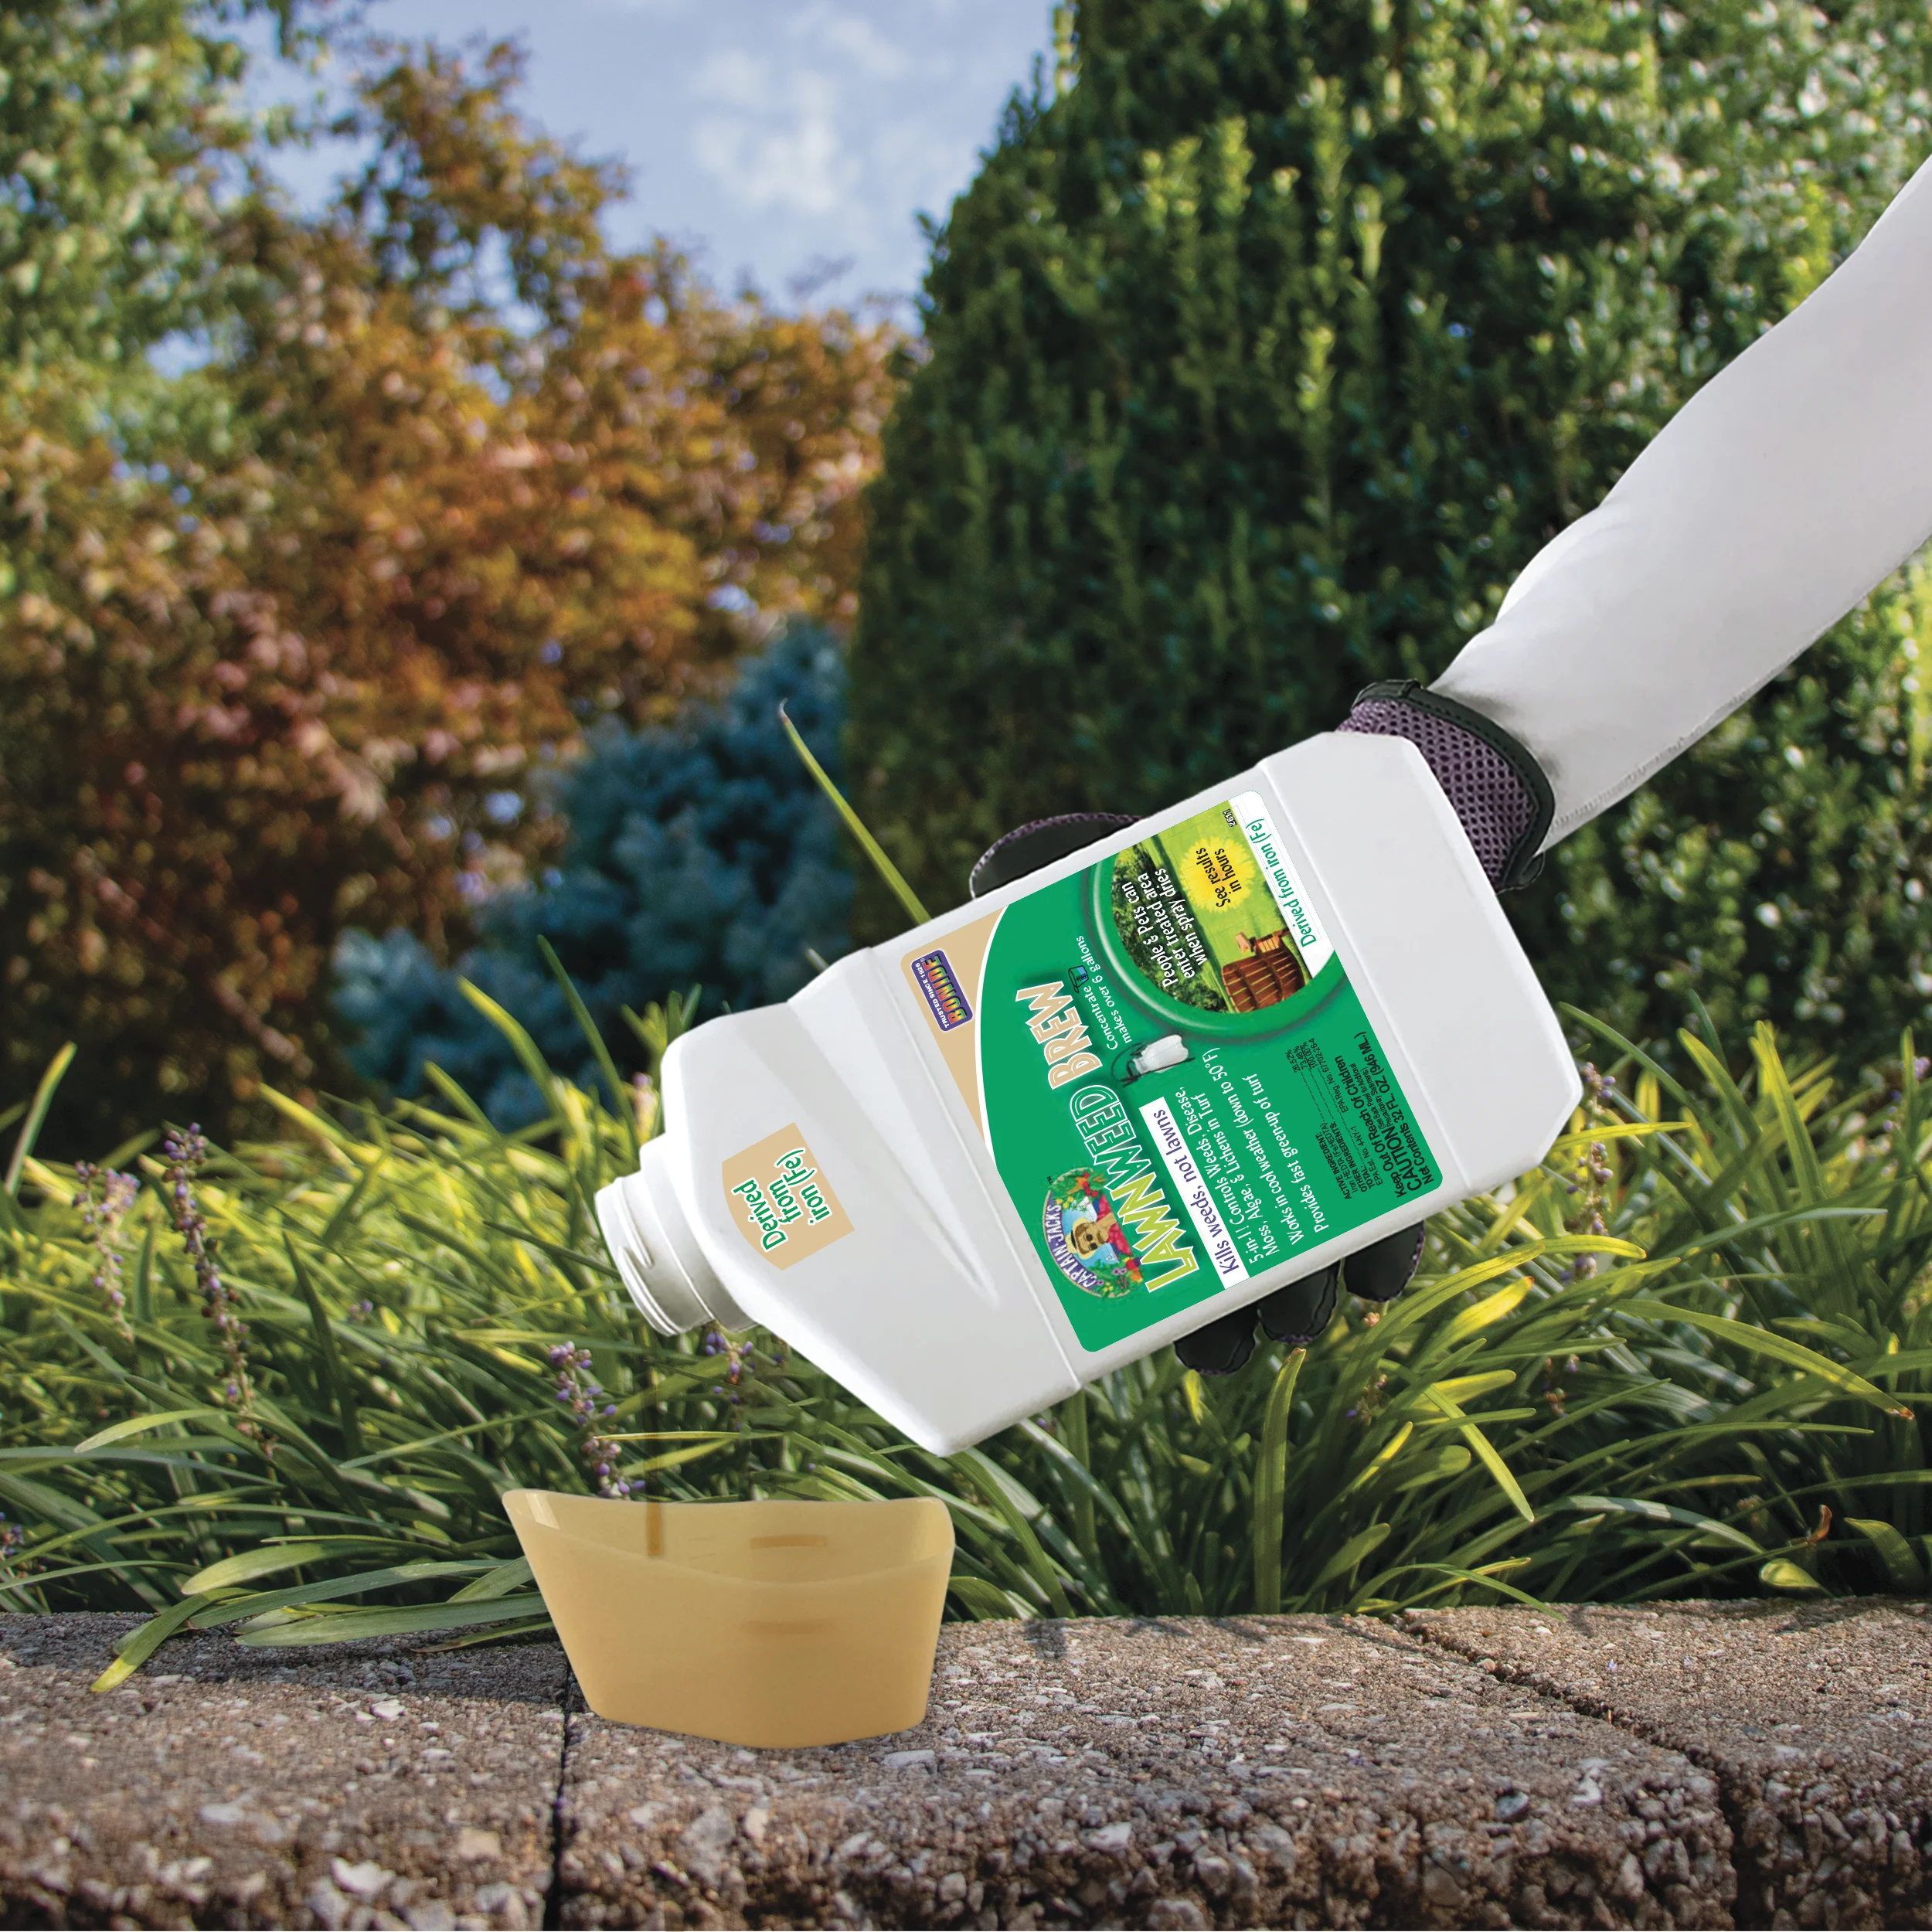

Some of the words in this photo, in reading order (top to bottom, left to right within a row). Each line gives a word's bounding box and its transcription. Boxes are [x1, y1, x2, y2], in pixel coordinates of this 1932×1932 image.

[1222, 808, 1237, 828] 2611
[1244, 818, 1272, 844] (Fe)
[1196, 847, 1220, 884] results
[1214, 848, 1235, 881] hours
[1260, 842, 1280, 869] iron
[1121, 881, 1140, 903] can
[1137, 872, 1158, 900] area
[1154, 868, 1176, 897] dries
[1214, 886, 1230, 907] See
[1228, 879, 1242, 893] in
[1273, 868, 1294, 899] from
[1132, 905, 1154, 935] Pets
[1145, 900, 1179, 947] treated
[1168, 898, 1195, 930] spray
[1282, 898, 1317, 947] Derived
[1076, 935, 1100, 972] gallons
[1142, 934, 1158, 945] &
[1184, 931, 1207, 965] when
[914, 961, 926, 978] 1926
[1149, 944, 1179, 988] People
[1171, 947, 1195, 978] enter
[921, 978, 935, 998] SINCE
[922, 955, 967, 1025] BONIDE
[1091, 975, 1103, 983] 6
[1098, 985, 1114, 1007] over
[932, 998, 950, 1029] TRUSTED
[1083, 985, 1118, 1049] Concentrate
[1110, 1009, 1132, 1043] makes
[1014, 980, 1103, 1090] BREW
[1353, 1031, 1372, 1055] ML.)
[1284, 1049, 1301, 1073] 26.52%
[1292, 1045, 1308, 1070] 73.48%
[1300, 1041, 1318, 1070] 100.00%
[1308, 1037, 1329, 1073] 67702-26-4
[1363, 1053, 1385, 1076] (946
[1220, 1080, 1234, 1094] to
[1241, 1073, 1264, 1096] turf
[1326, 1073, 1335, 1084] No.
[1334, 1054, 1359, 1096] Children
[1175, 1087, 1202, 1135] Disease,
[1189, 1092, 1213, 1119] Turf
[1227, 1093, 1253, 1128] (down
[1252, 1096, 1270, 1109] of
[1337, 1097, 1349, 1113] EPA
[1349, 1095, 1365, 1109] Of
[1384, 1092, 1399, 1111] FL.
[1390, 1108, 1404, 1123] 32
[1153, 1109, 1182, 1155] lawns
[1206, 1117, 1220, 1132] in
[1264, 1111, 1298, 1158] green-up
[1349, 1124, 1364, 1146] 4-NY-1
[1358, 1107, 1380, 1141] Reach
[1196, 1134, 1221, 1179] Weeds,
[1213, 1131, 1240, 1174] Lichens
[1243, 1128, 1270, 1172] weather
[1315, 1131, 1340, 1175] INGREDIENT:
[1328, 1121, 1356, 1168] INGREDIENTS:
[1370, 1138, 1386, 1153] Of
[1380, 1124, 1422, 1191] CAUTION
[1399, 1121, 1425, 1166] Contents
[776, 1149, 815, 1186] (Fe)
[1173, 1155, 1197, 1182] not
[1287, 1159, 1305, 1183] fast
[1378, 1151, 1394, 1172] Out
[1417, 1165, 1434, 1185] Net
[1229, 1173, 1244, 1183] &
[1259, 1170, 1281, 1194] cool
[1335, 1173, 1352, 1199] ACTIVE
[1351, 1167, 1368, 1192] OTHER
[1372, 1169, 1383, 1185] EPA
[1389, 1168, 1407, 1198] Keep
[733, 1179, 787, 1250] Derived
[768, 1179, 802, 1223] from
[801, 1184, 831, 1224] iron
[1189, 1185, 1222, 1237] weeds,
[1214, 1176, 1245, 1225] Controls
[1240, 1183, 1263, 1219] Algae,
[1274, 1193, 1288, 1209] in
[1299, 1184, 1329, 1233] Provides
[1257, 1220, 1280, 1256] Moss,
[1280, 1206, 1304, 1245] Works
[1053, 1244, 1097, 1287] CAPTAIN
[1214, 1240, 1239, 1274] Kills
